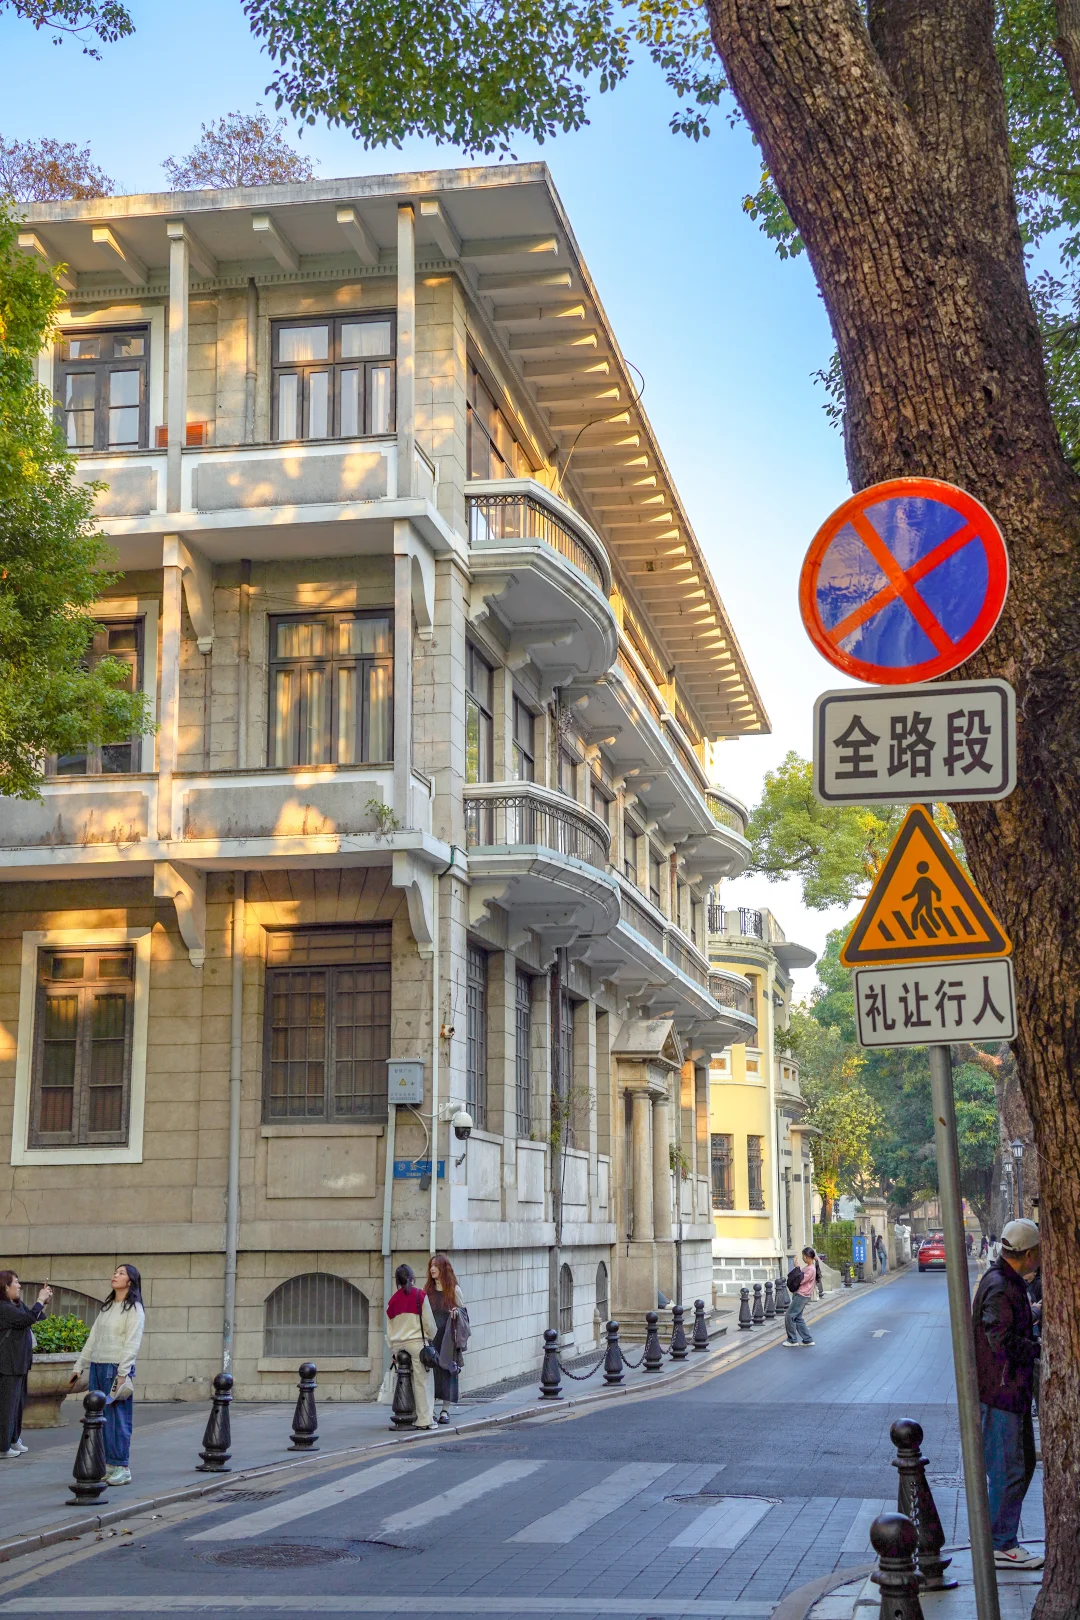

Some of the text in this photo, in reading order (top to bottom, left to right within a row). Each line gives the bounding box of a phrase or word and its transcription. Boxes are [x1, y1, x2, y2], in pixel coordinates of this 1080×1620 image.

[832, 708, 994, 781] 全路段
[864, 975, 1006, 1033] 礼让行人
